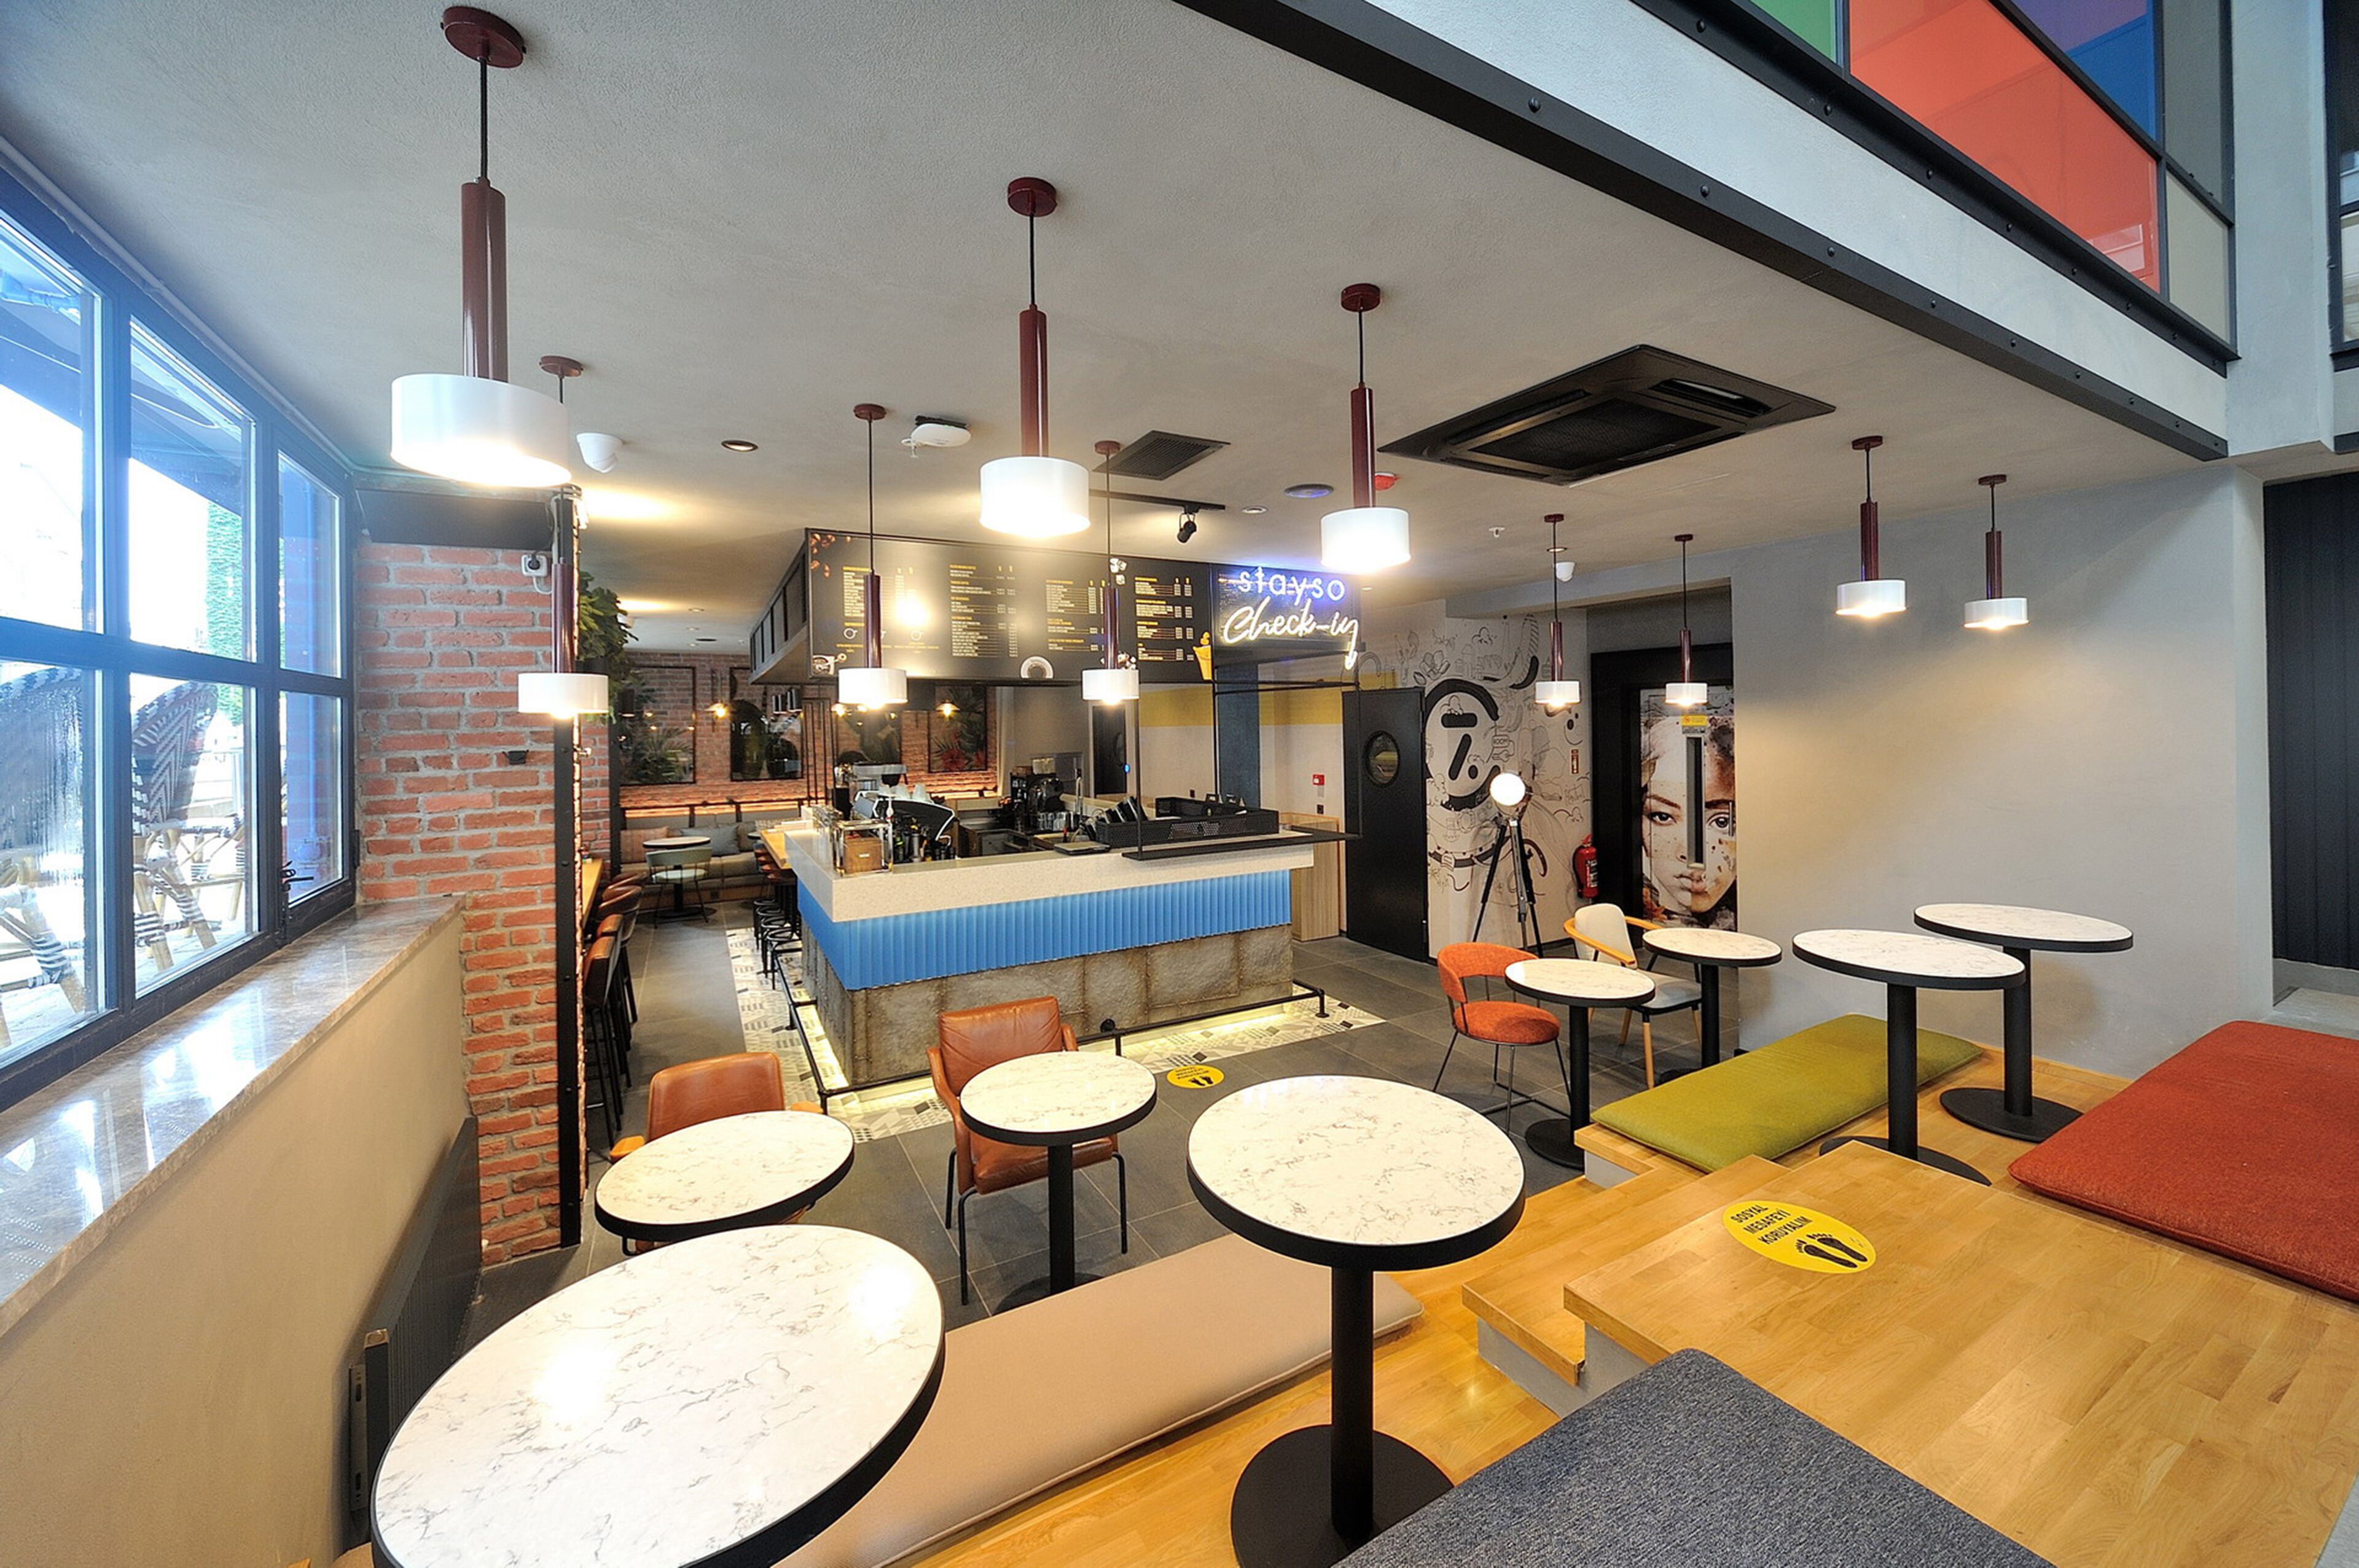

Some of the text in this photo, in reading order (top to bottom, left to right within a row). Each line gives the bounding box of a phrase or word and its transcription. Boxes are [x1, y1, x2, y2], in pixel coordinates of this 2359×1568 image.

[1238, 566, 1346, 606] stayso
[1731, 1204, 1768, 1223] SOSYAL
[1758, 1215, 1813, 1245] KORUYALIM
